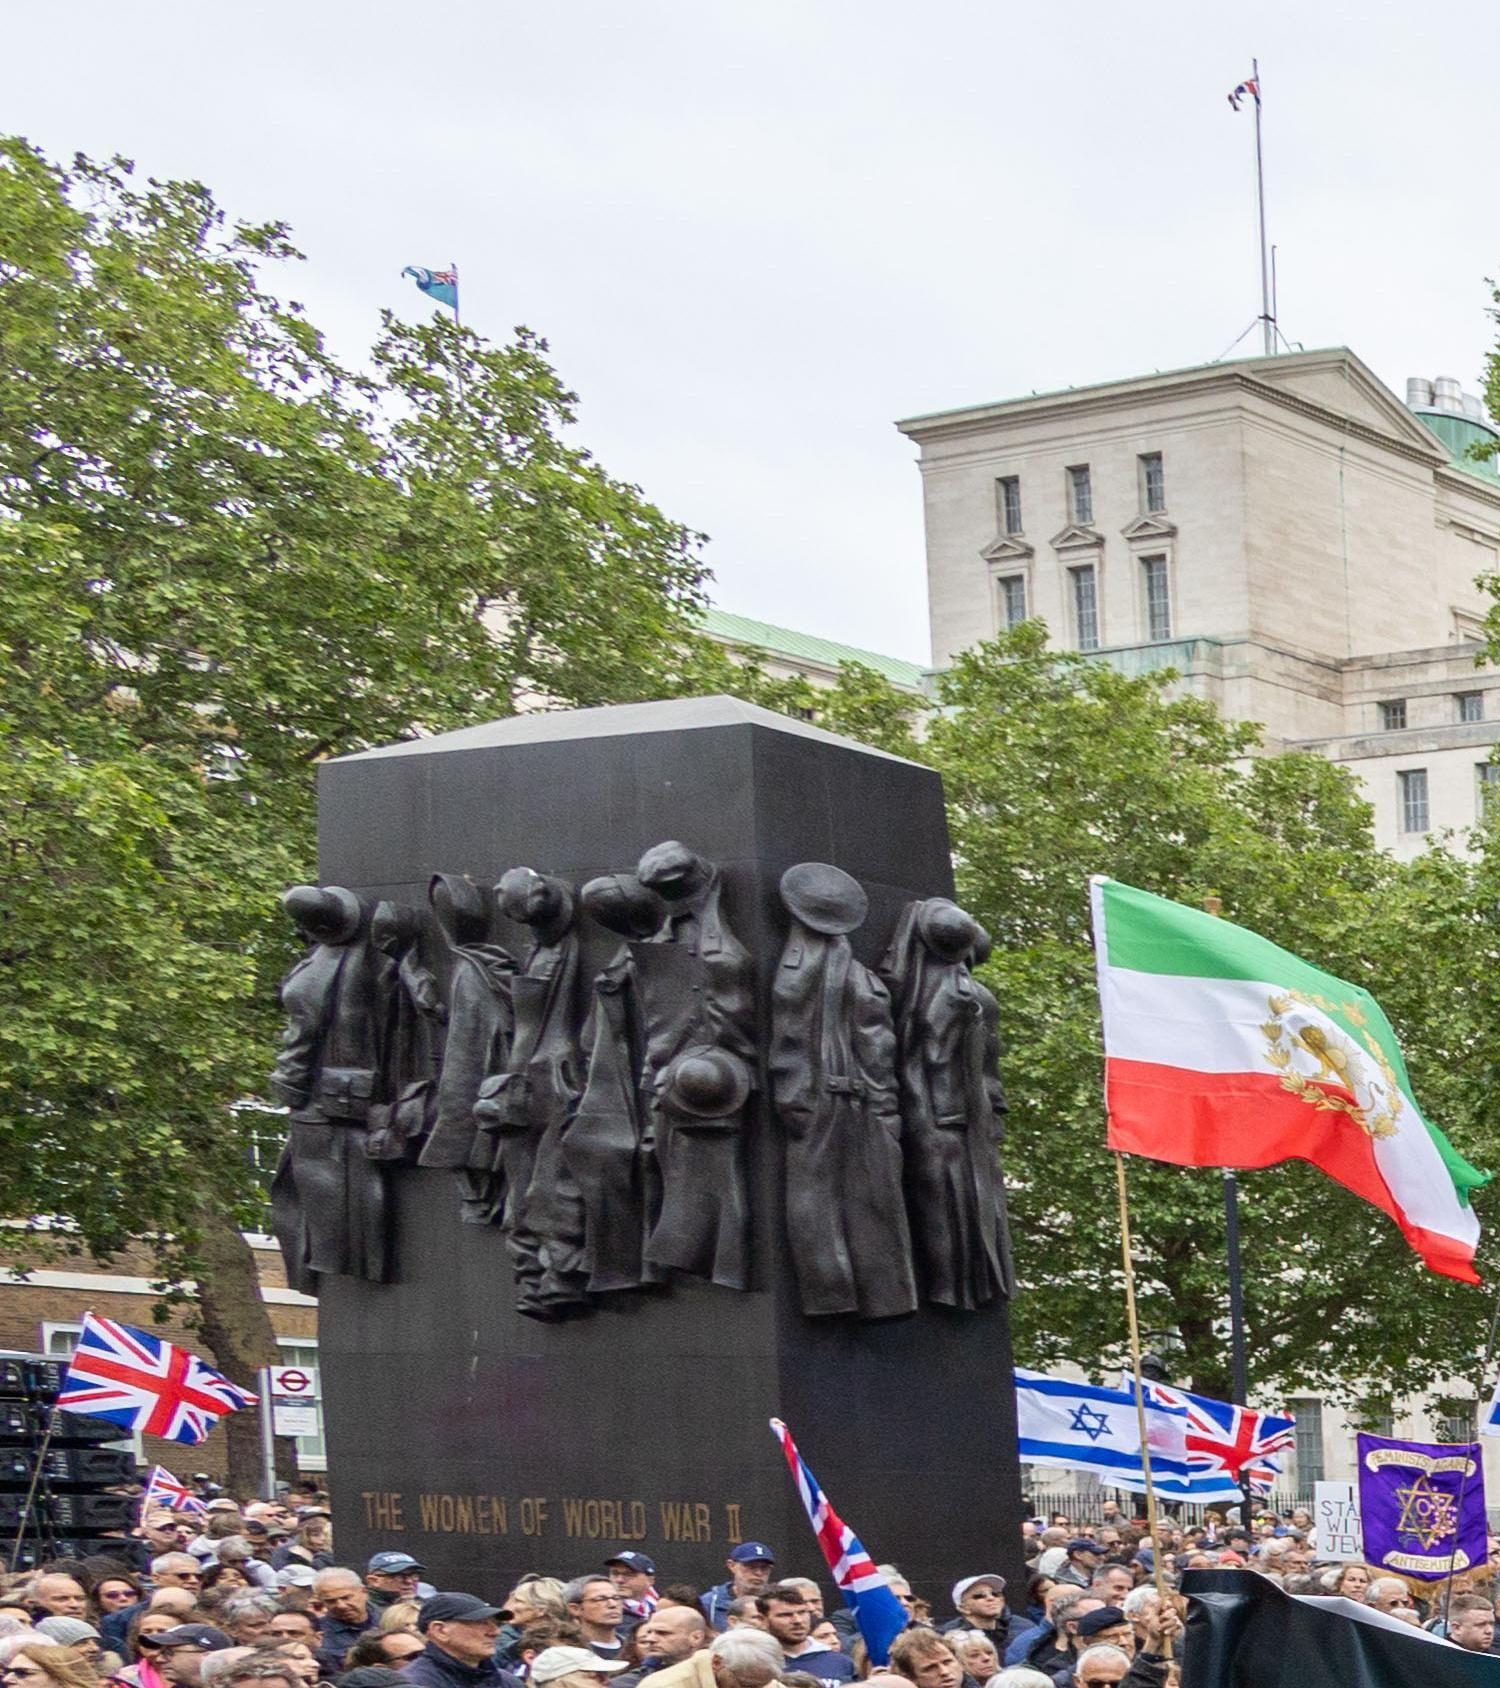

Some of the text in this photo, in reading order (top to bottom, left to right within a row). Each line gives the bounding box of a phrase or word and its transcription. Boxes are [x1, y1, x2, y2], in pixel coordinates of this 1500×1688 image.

[1321, 1500, 1361, 1517] STA
[361, 1492, 742, 1544] THE WOMEN OF WORLD WAR II
[1327, 1518, 1361, 1535] WIT
[1326, 1534, 1363, 1554] JEW
